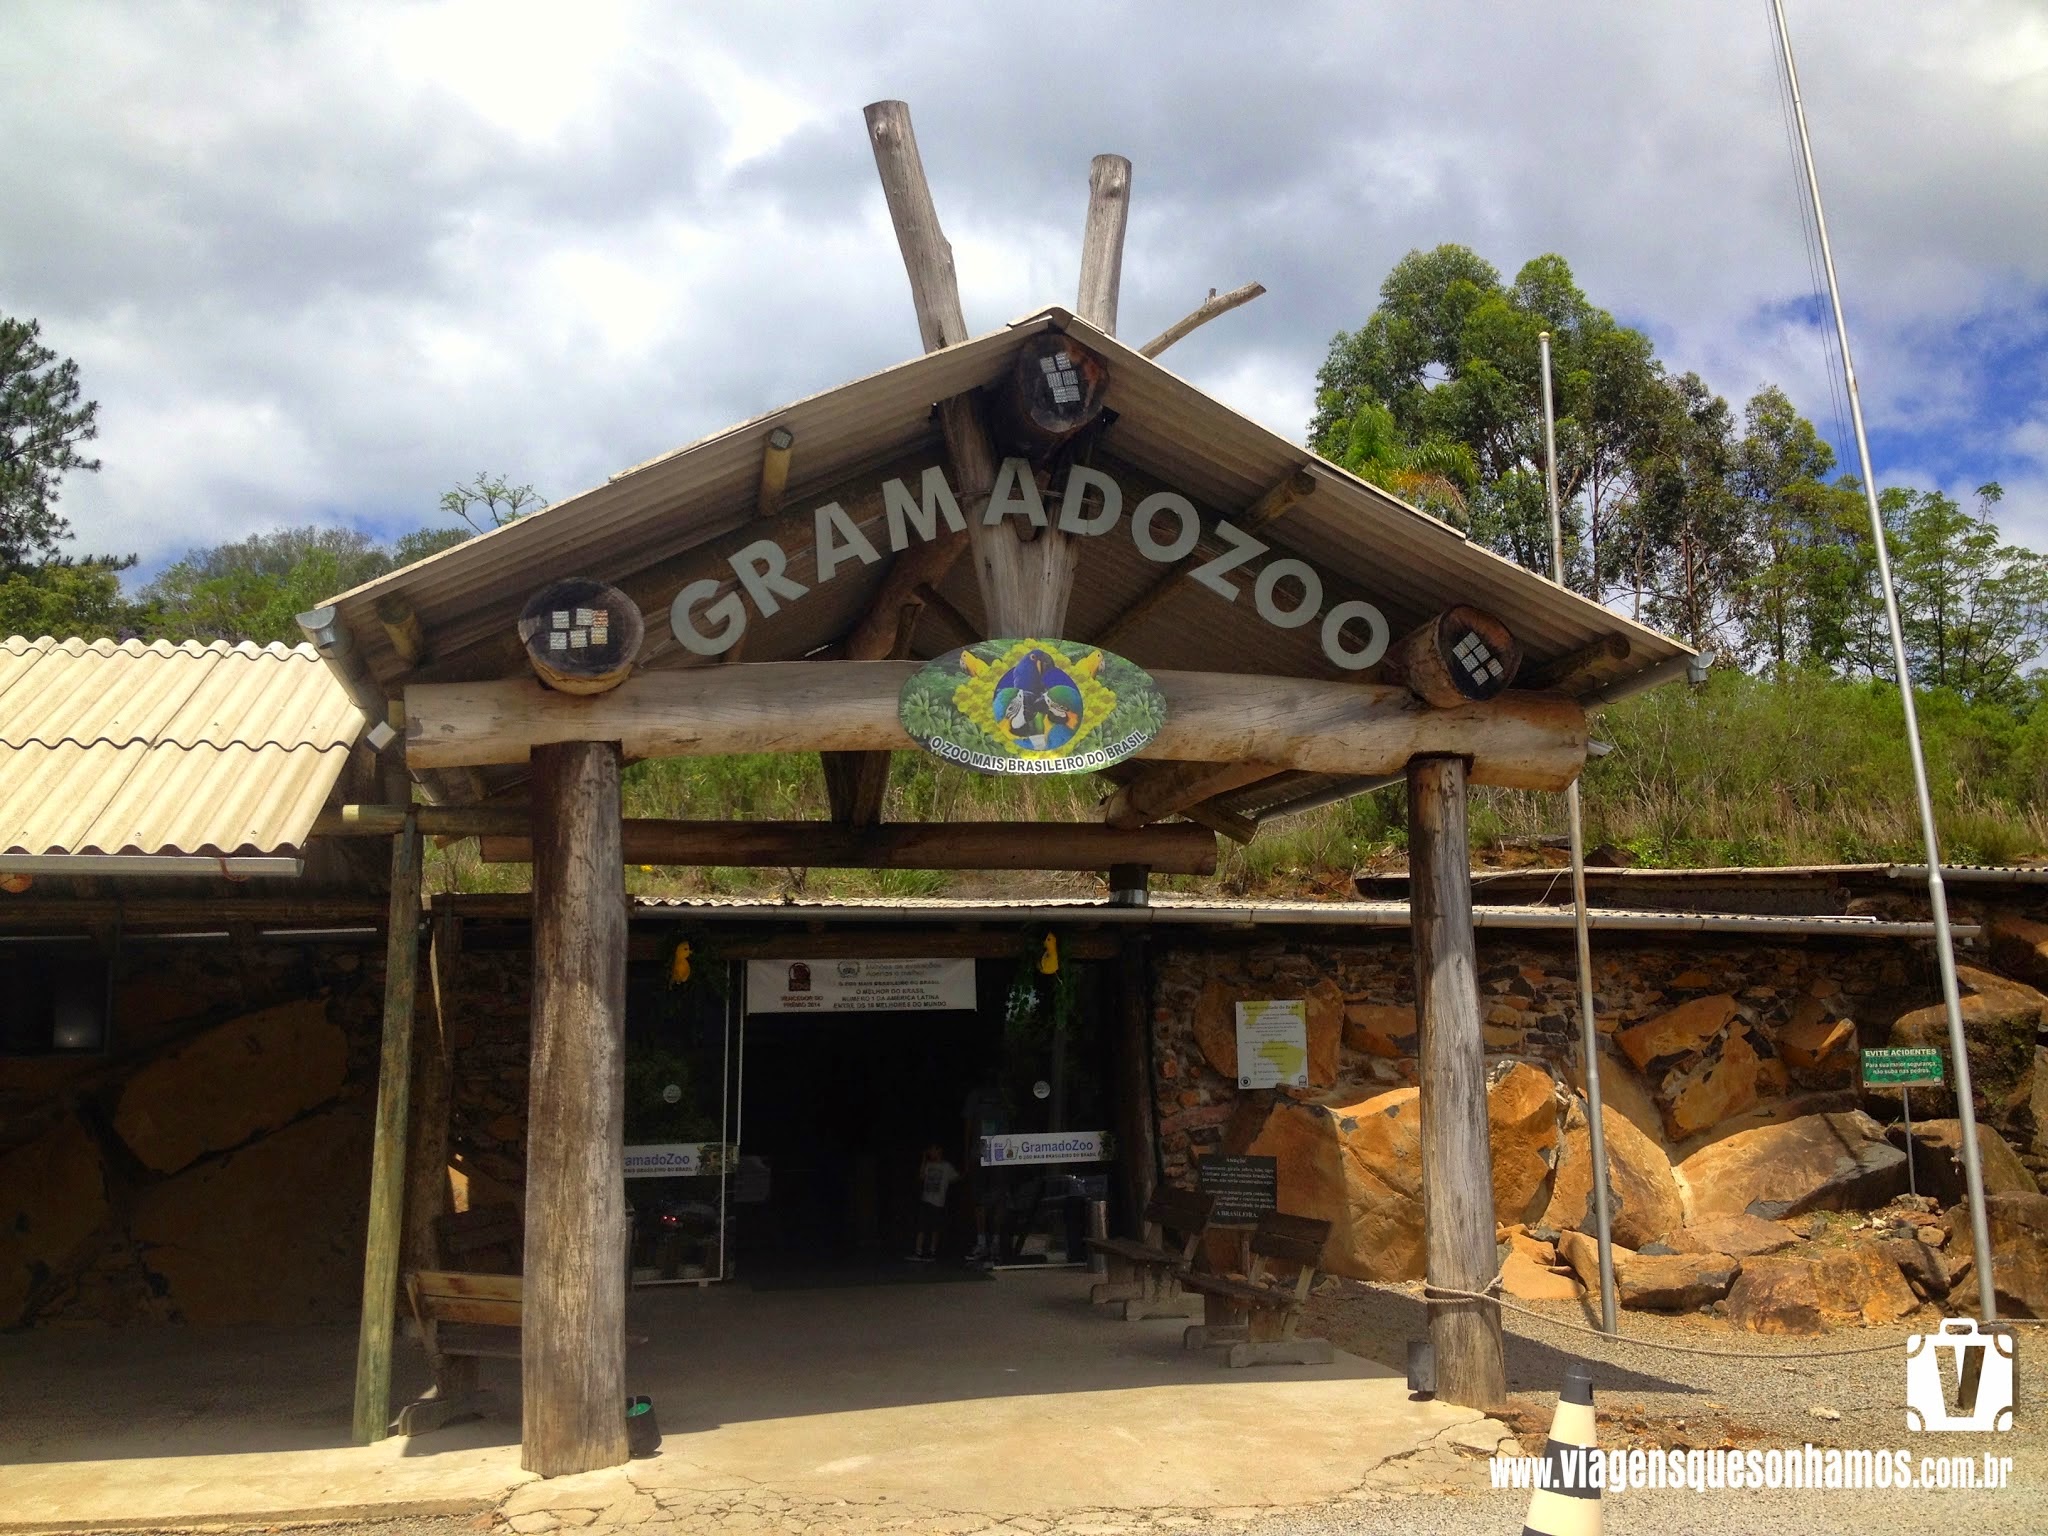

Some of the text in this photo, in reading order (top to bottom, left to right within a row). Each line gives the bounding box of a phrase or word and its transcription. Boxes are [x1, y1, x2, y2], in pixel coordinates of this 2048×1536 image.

[670, 457, 1390, 670] GRAMADOZOO
[930, 730, 1148, 773] O ZOO MAIS BRASILEIRO DO BRASIL
[1891, 1048, 1937, 1056] ACIDENTES
[1021, 1140, 1094, 1153] GramadoZoo
[624, 1153, 690, 1166] amadoZoo
